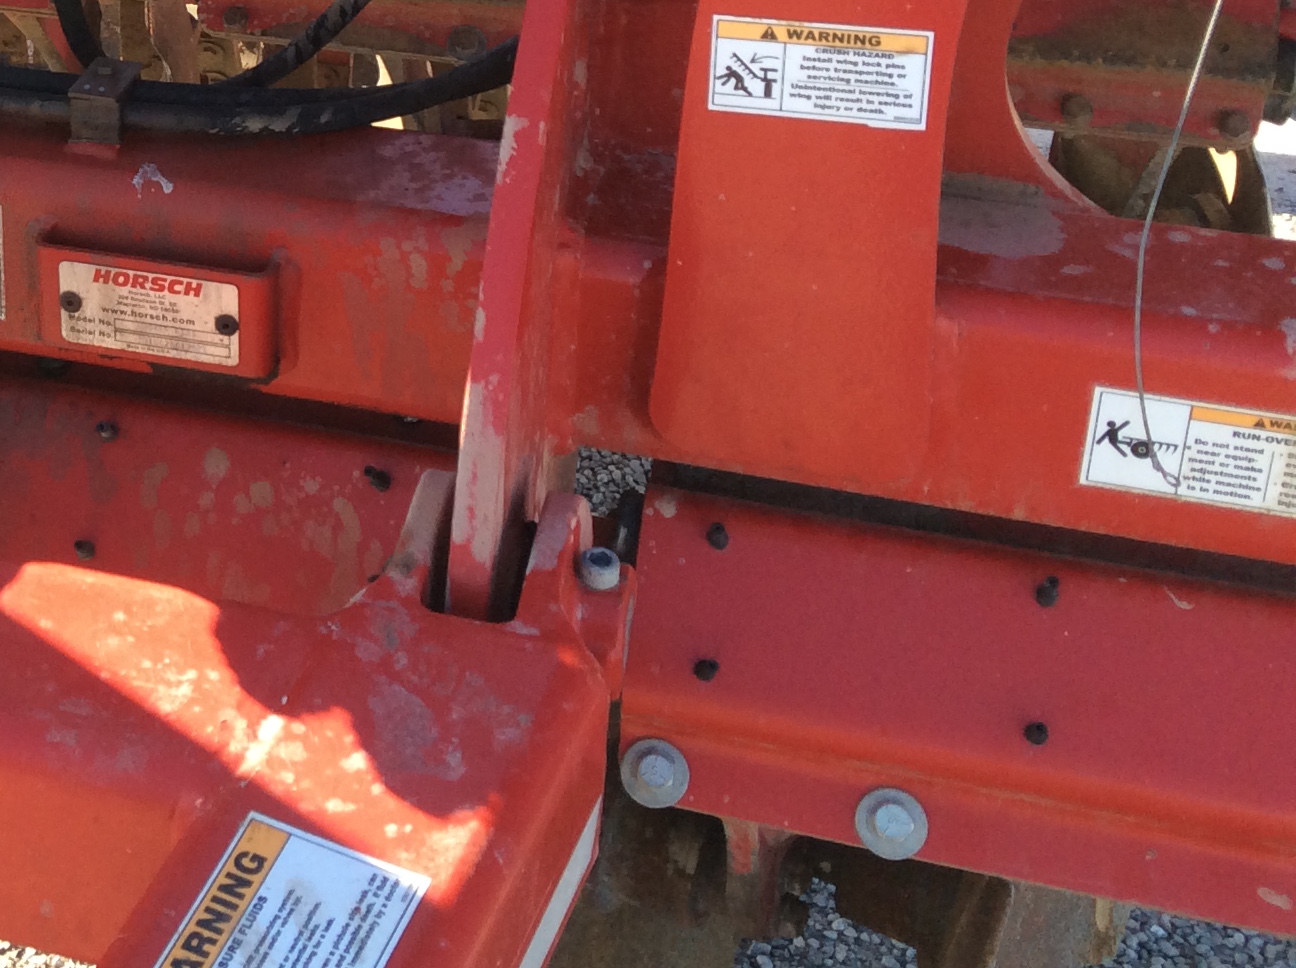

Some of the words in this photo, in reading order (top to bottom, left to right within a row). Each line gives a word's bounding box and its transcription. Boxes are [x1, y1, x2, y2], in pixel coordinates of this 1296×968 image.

[786, 28, 881, 47] WARNING
[815, 48, 850, 56] CRUSH
[853, 50, 894, 60] HAZARD
[803, 55, 833, 64] Install
[836, 59, 859, 67] wing
[862, 60, 882, 68] lock
[800, 64, 831, 72] before
[834, 67, 894, 78] transporting
[807, 74, 851, 84] servicing
[854, 78, 898, 87] machine.
[791, 83, 856, 94] Unintentional
[859, 89, 900, 99] lowering
[856, 107, 887, 115] death.
[878, 101, 913, 109] serious
[92, 268, 203, 298] HORSCH
[69, 314, 96, 324] Model
[102, 307, 195, 326] www.horsch.com
[70, 325, 96, 335] Serial
[1270, 420, 1296, 432] WA
[1197, 449, 1220, 457] near
[1234, 445, 1264, 455] stand
[1189, 457, 1215, 466] ment
[1234, 464, 1263, 473] make
[1190, 467, 1257, 482] adjustments
[1183, 475, 1211, 484] while
[1215, 479, 1262, 492] machine
[1213, 489, 1253, 500] motion.
[241, 895, 268, 937] FLUIDS
